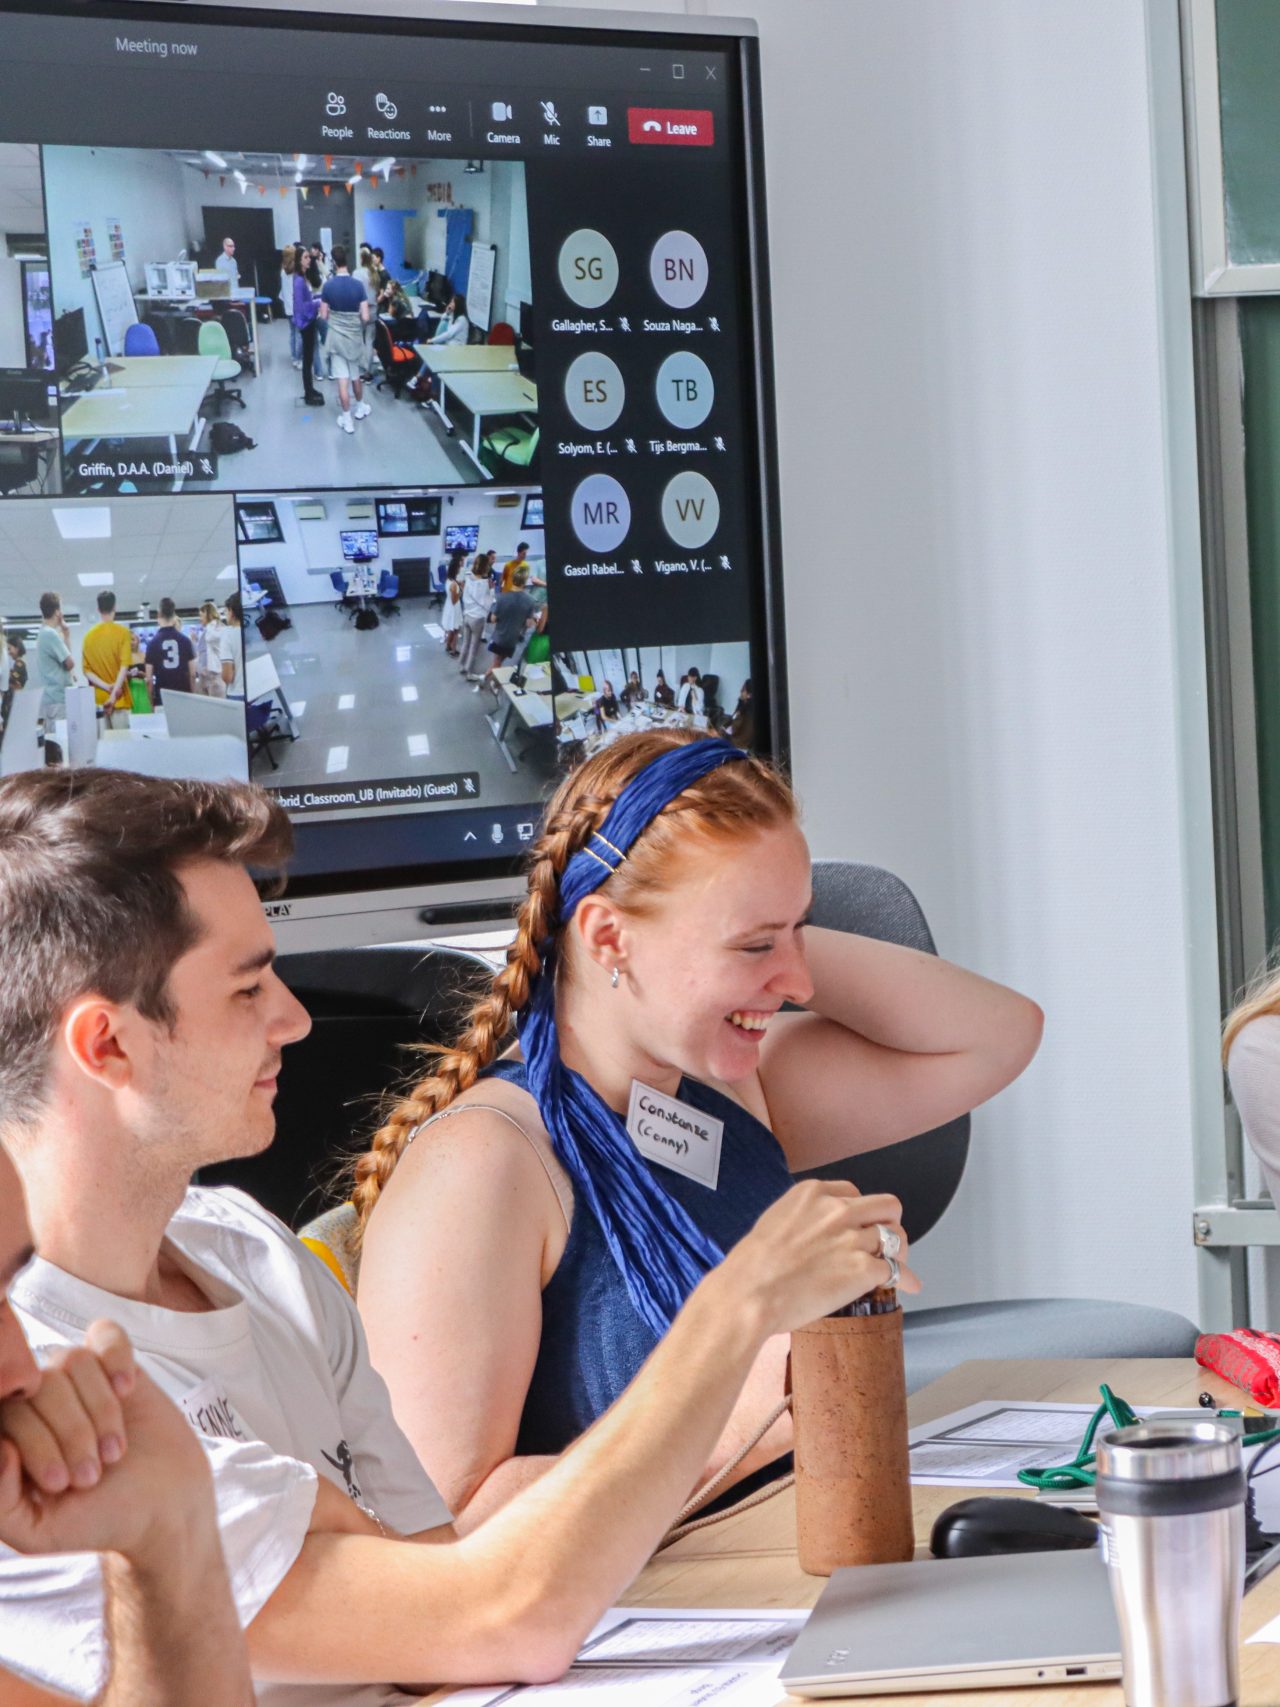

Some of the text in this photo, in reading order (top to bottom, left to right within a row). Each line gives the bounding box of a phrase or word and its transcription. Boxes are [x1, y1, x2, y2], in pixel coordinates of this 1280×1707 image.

[115, 36, 198, 58] Meeting now
[321, 125, 354, 141] People
[367, 127, 411, 141] Reactions
[427, 129, 452, 142] More
[666, 121, 698, 136] Leave
[486, 131, 521, 144] Camera
[543, 134, 561, 146] Mic
[587, 135, 612, 147] Share
[574, 257, 604, 281] SG
[664, 258, 694, 281] BN
[551, 319, 598, 334] Gallagher,
[643, 319, 671, 332] Souza
[583, 379, 608, 403] ES
[671, 378, 698, 402] TB
[557, 442, 595, 457] Solyom,
[649, 440, 665, 455] Tijs
[79, 462, 194, 477] Griffin, D.A.A. (Daniel)
[583, 501, 620, 525] MR
[675, 498, 705, 521] VV
[564, 564, 590, 577] Gasol
[689, 559, 700, 571] V.
[161, 638, 181, 670] 3
[376, 785, 422, 802] (Invitado)
[424, 782, 459, 798] (Guest)
[638, 1095, 709, 1142] Constanze
